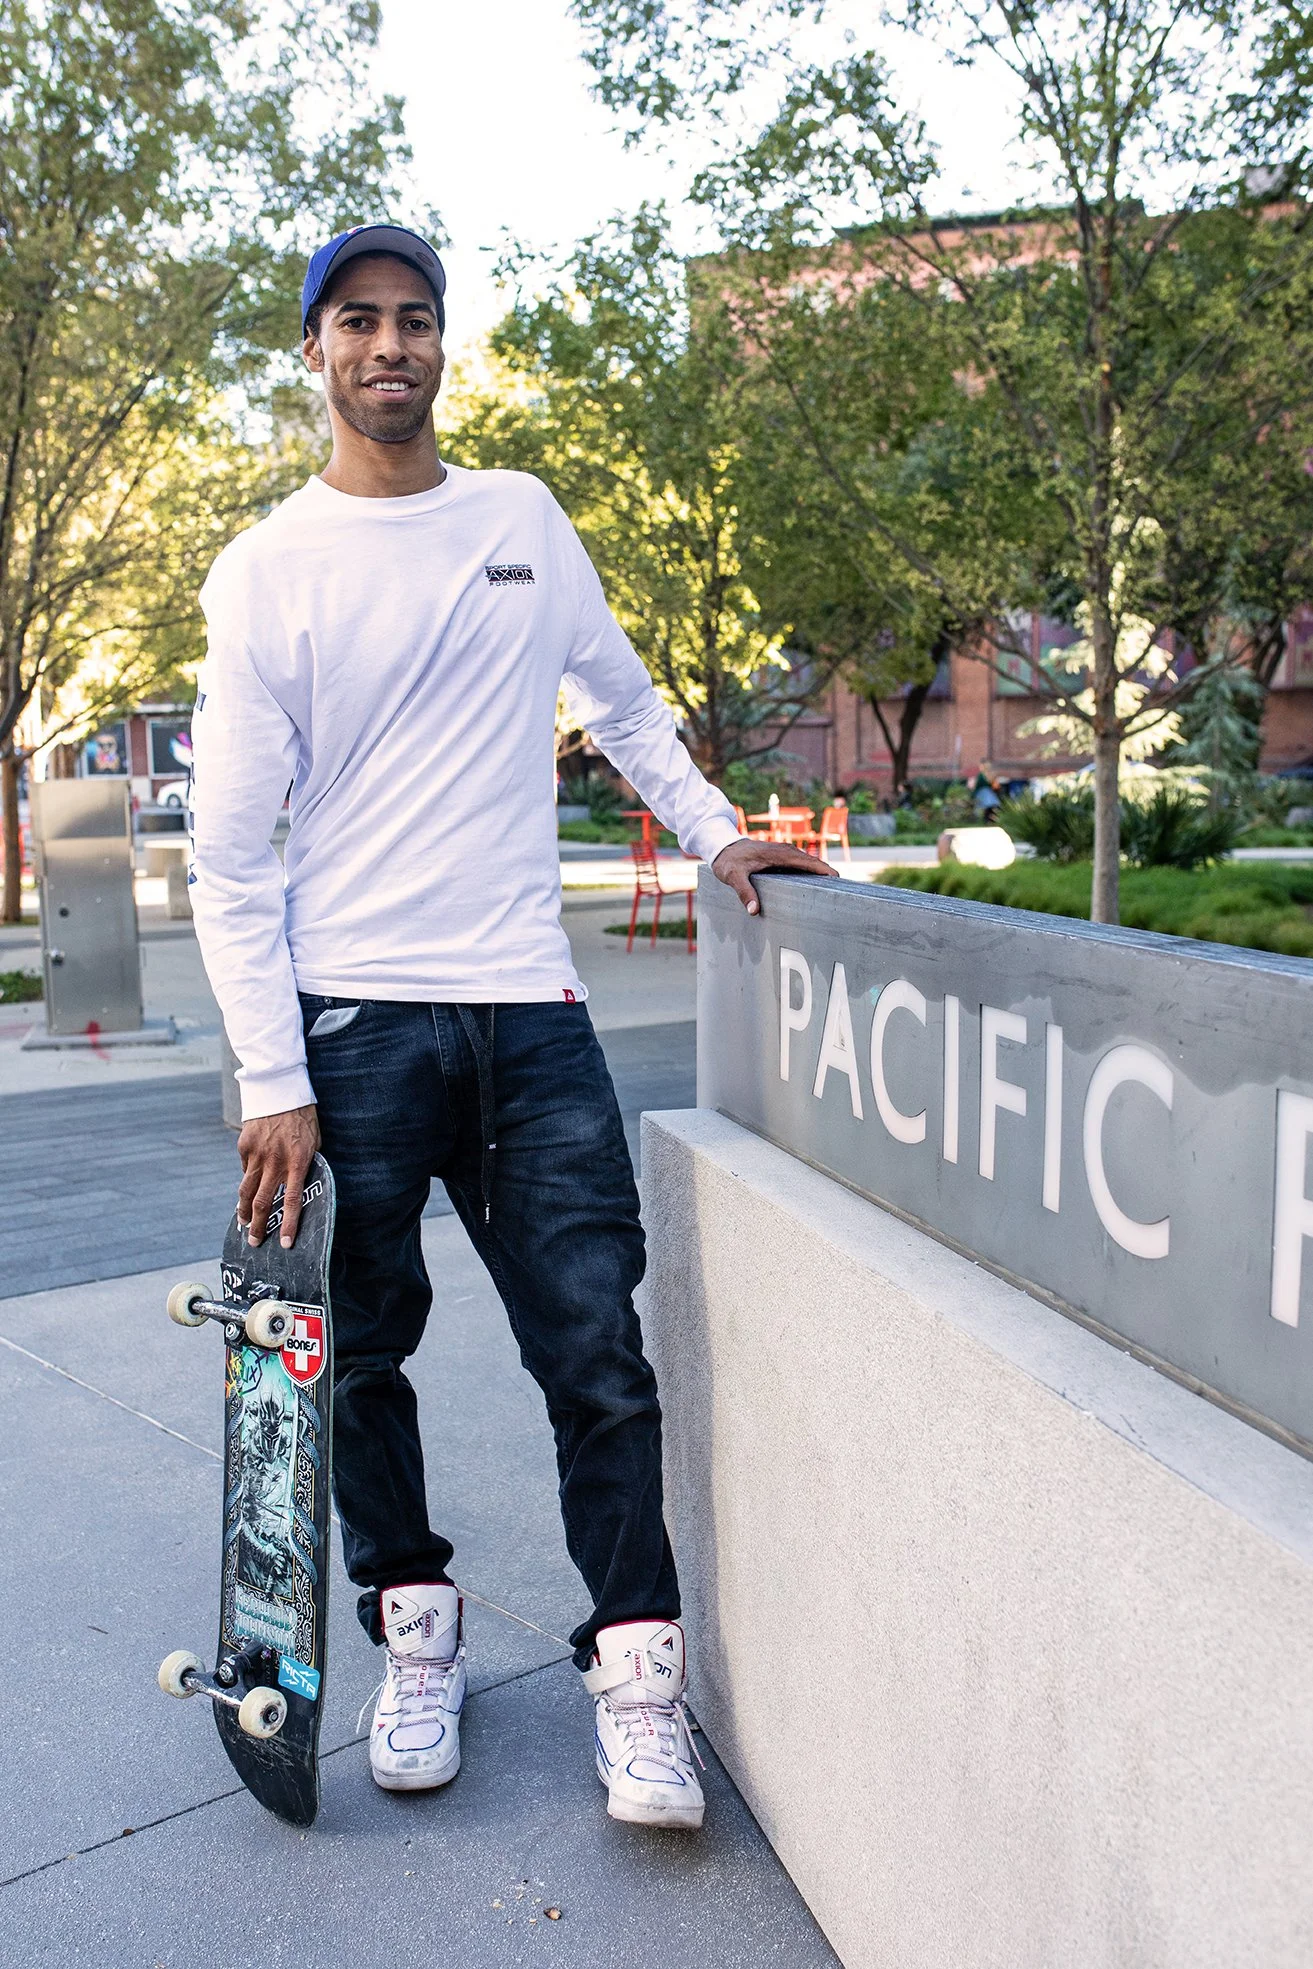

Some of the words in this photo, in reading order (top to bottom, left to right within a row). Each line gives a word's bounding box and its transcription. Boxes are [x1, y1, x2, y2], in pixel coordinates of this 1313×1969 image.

[485, 569, 535, 581] AXION
[779, 946, 1173, 1260] PACIFIC
[286, 1338, 317, 1352] BONES
[281, 1659, 317, 1698] RICTA
[634, 1653, 642, 1680] axion
